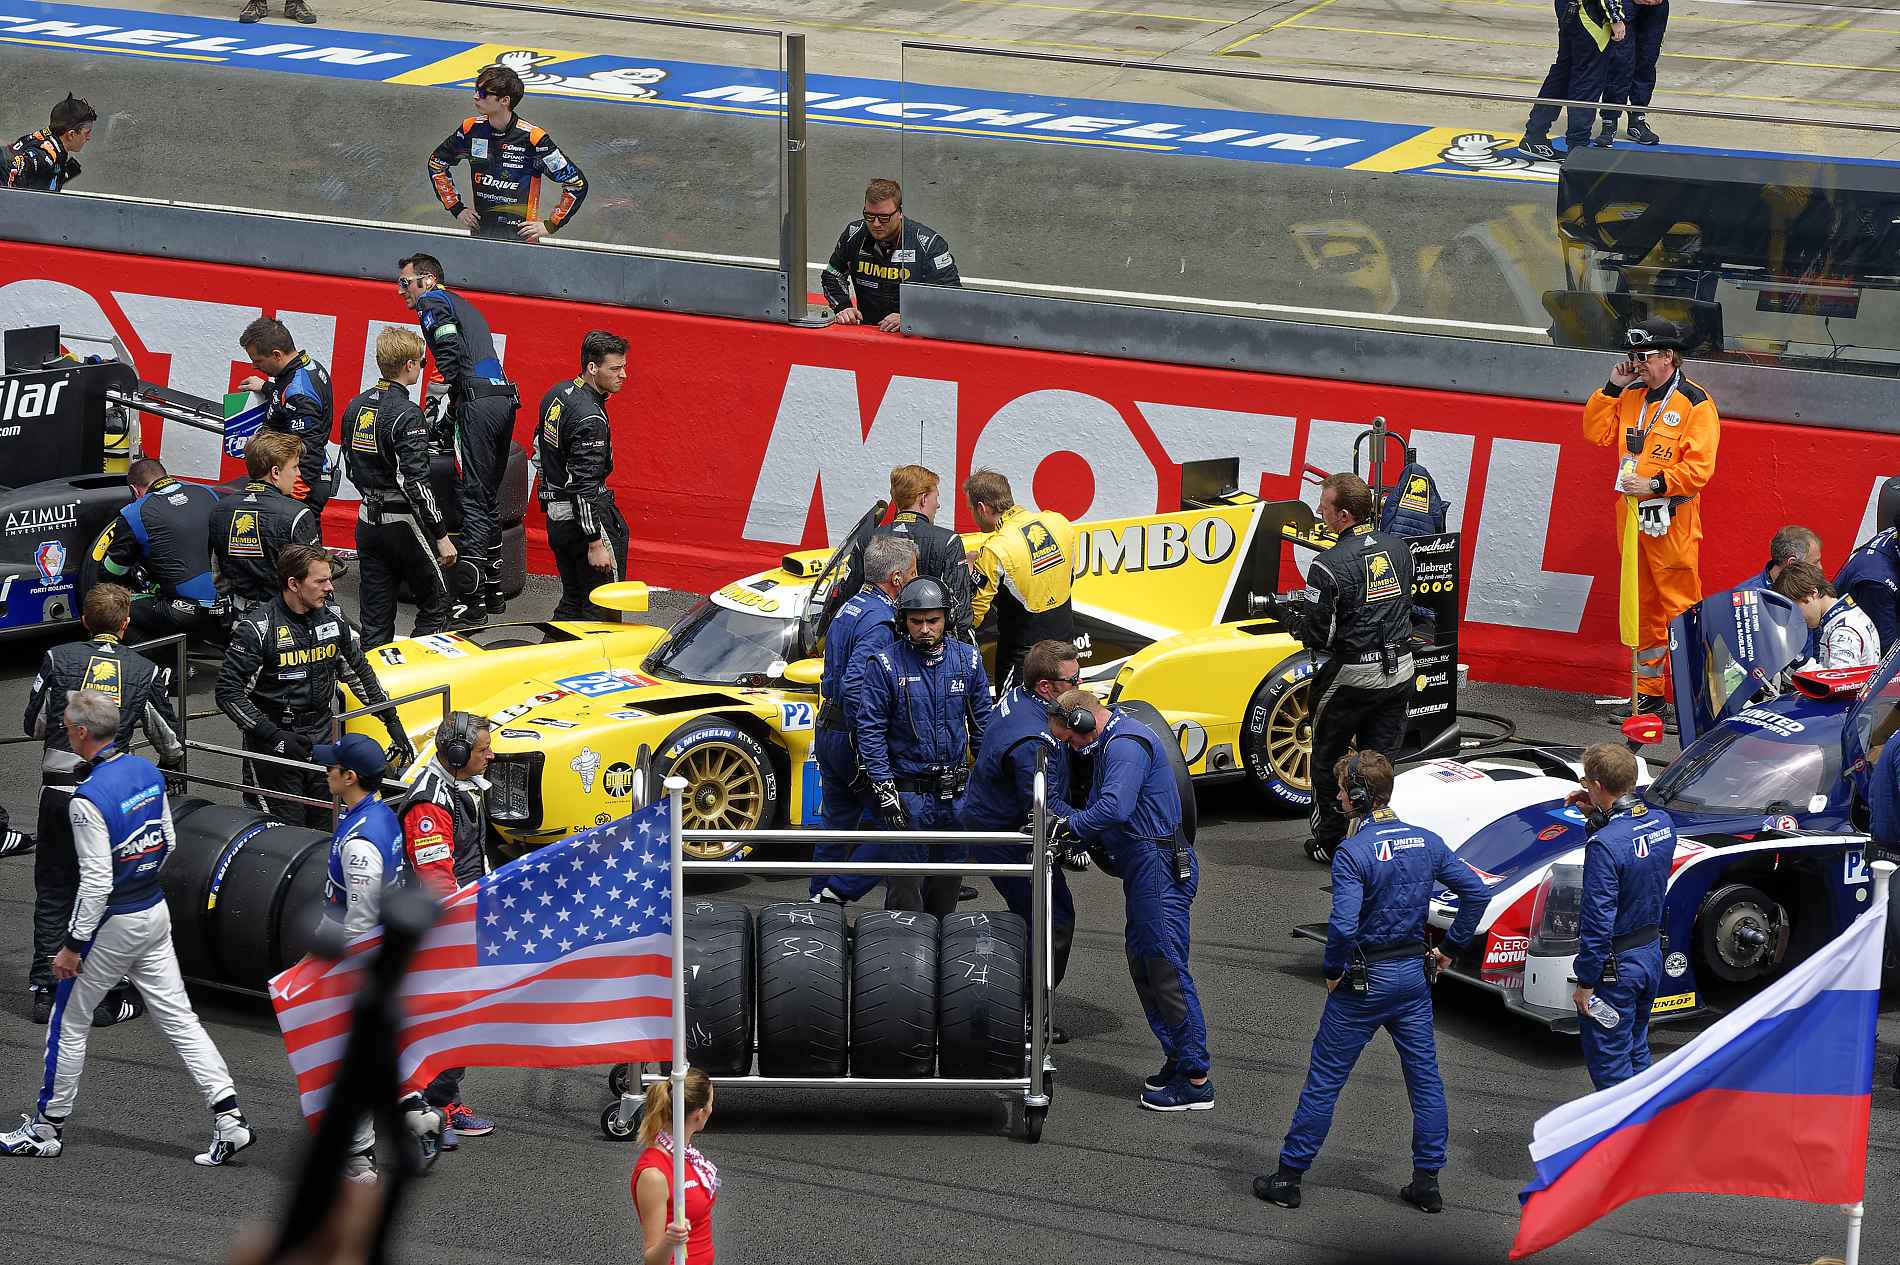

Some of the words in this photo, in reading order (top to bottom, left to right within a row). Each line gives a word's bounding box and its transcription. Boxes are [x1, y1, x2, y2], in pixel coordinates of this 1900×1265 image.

[0, 16, 412, 66] HELIN
[681, 85, 1364, 152] MICHELIN
[857, 261, 911, 280] JUMBO
[5, 504, 77, 528] AZIMUT
[5, 522, 77, 536] INVESTIMENTI
[1032, 544, 1057, 560] JUMBO
[1074, 516, 1236, 580] MBO
[1369, 577, 1395, 589] JUMBO
[1073, 632, 1091, 650] ot
[277, 643, 337, 667] JUMBO
[1077, 650, 1093, 658] roup
[783, 703, 811, 727] P2
[1408, 702, 1449, 715] MICHELIN
[1739, 708, 1805, 733] UNITED
[683, 730, 732, 746] MICHELIN
[1272, 783, 1312, 805] CHELIN
[1393, 837, 1425, 846] UNITED
[1493, 940, 1529, 951] AERO
[1486, 950, 1527, 963] MOTUL
[1653, 997, 1692, 1009] UNLOP
